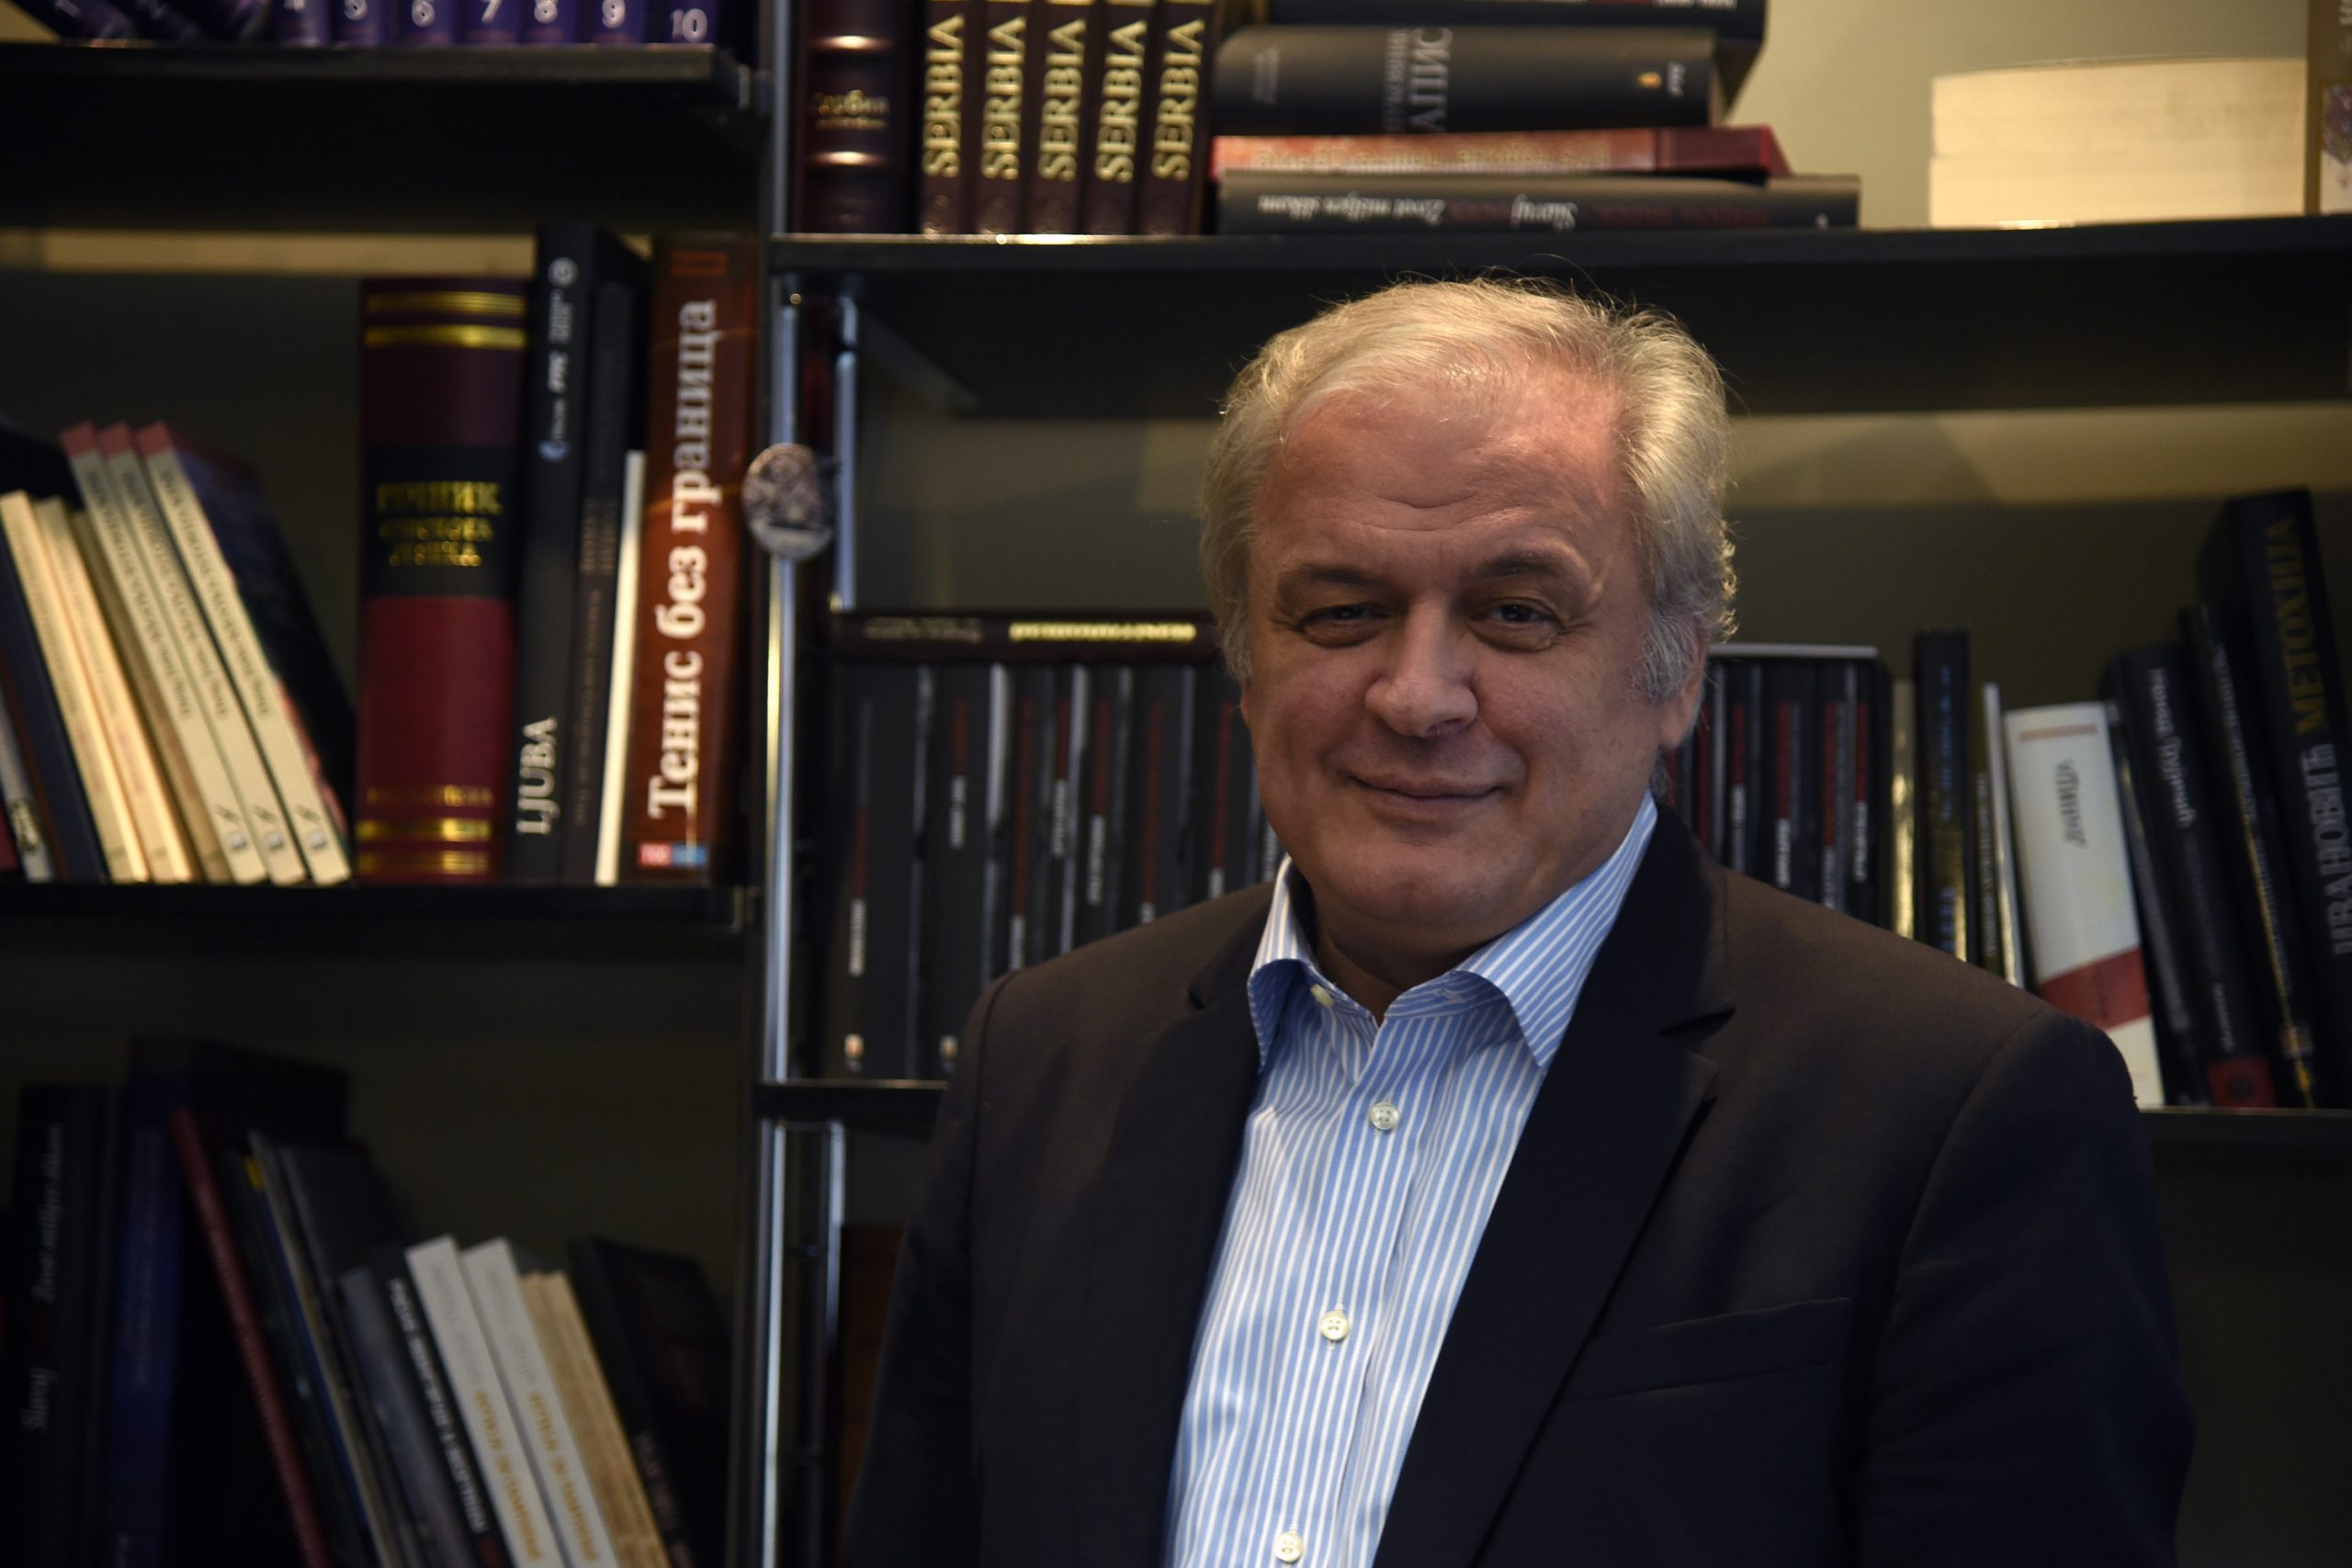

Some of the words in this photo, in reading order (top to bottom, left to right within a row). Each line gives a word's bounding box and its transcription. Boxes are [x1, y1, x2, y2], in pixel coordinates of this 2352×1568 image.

[670, 7, 708, 43] 10
[922, 13, 965, 179] SERBIA
[980, 15, 1027, 181] SERBIA
[1037, 17, 1088, 183] SERBIA
[1095, 19, 1148, 184] SERBIA
[1151, 18, 1206, 183] SERBIA
[670, 299, 723, 535] граница
[655, 546, 707, 640] без
[515, 716, 558, 836] LJUBA
[649, 649, 704, 818] Тенис
